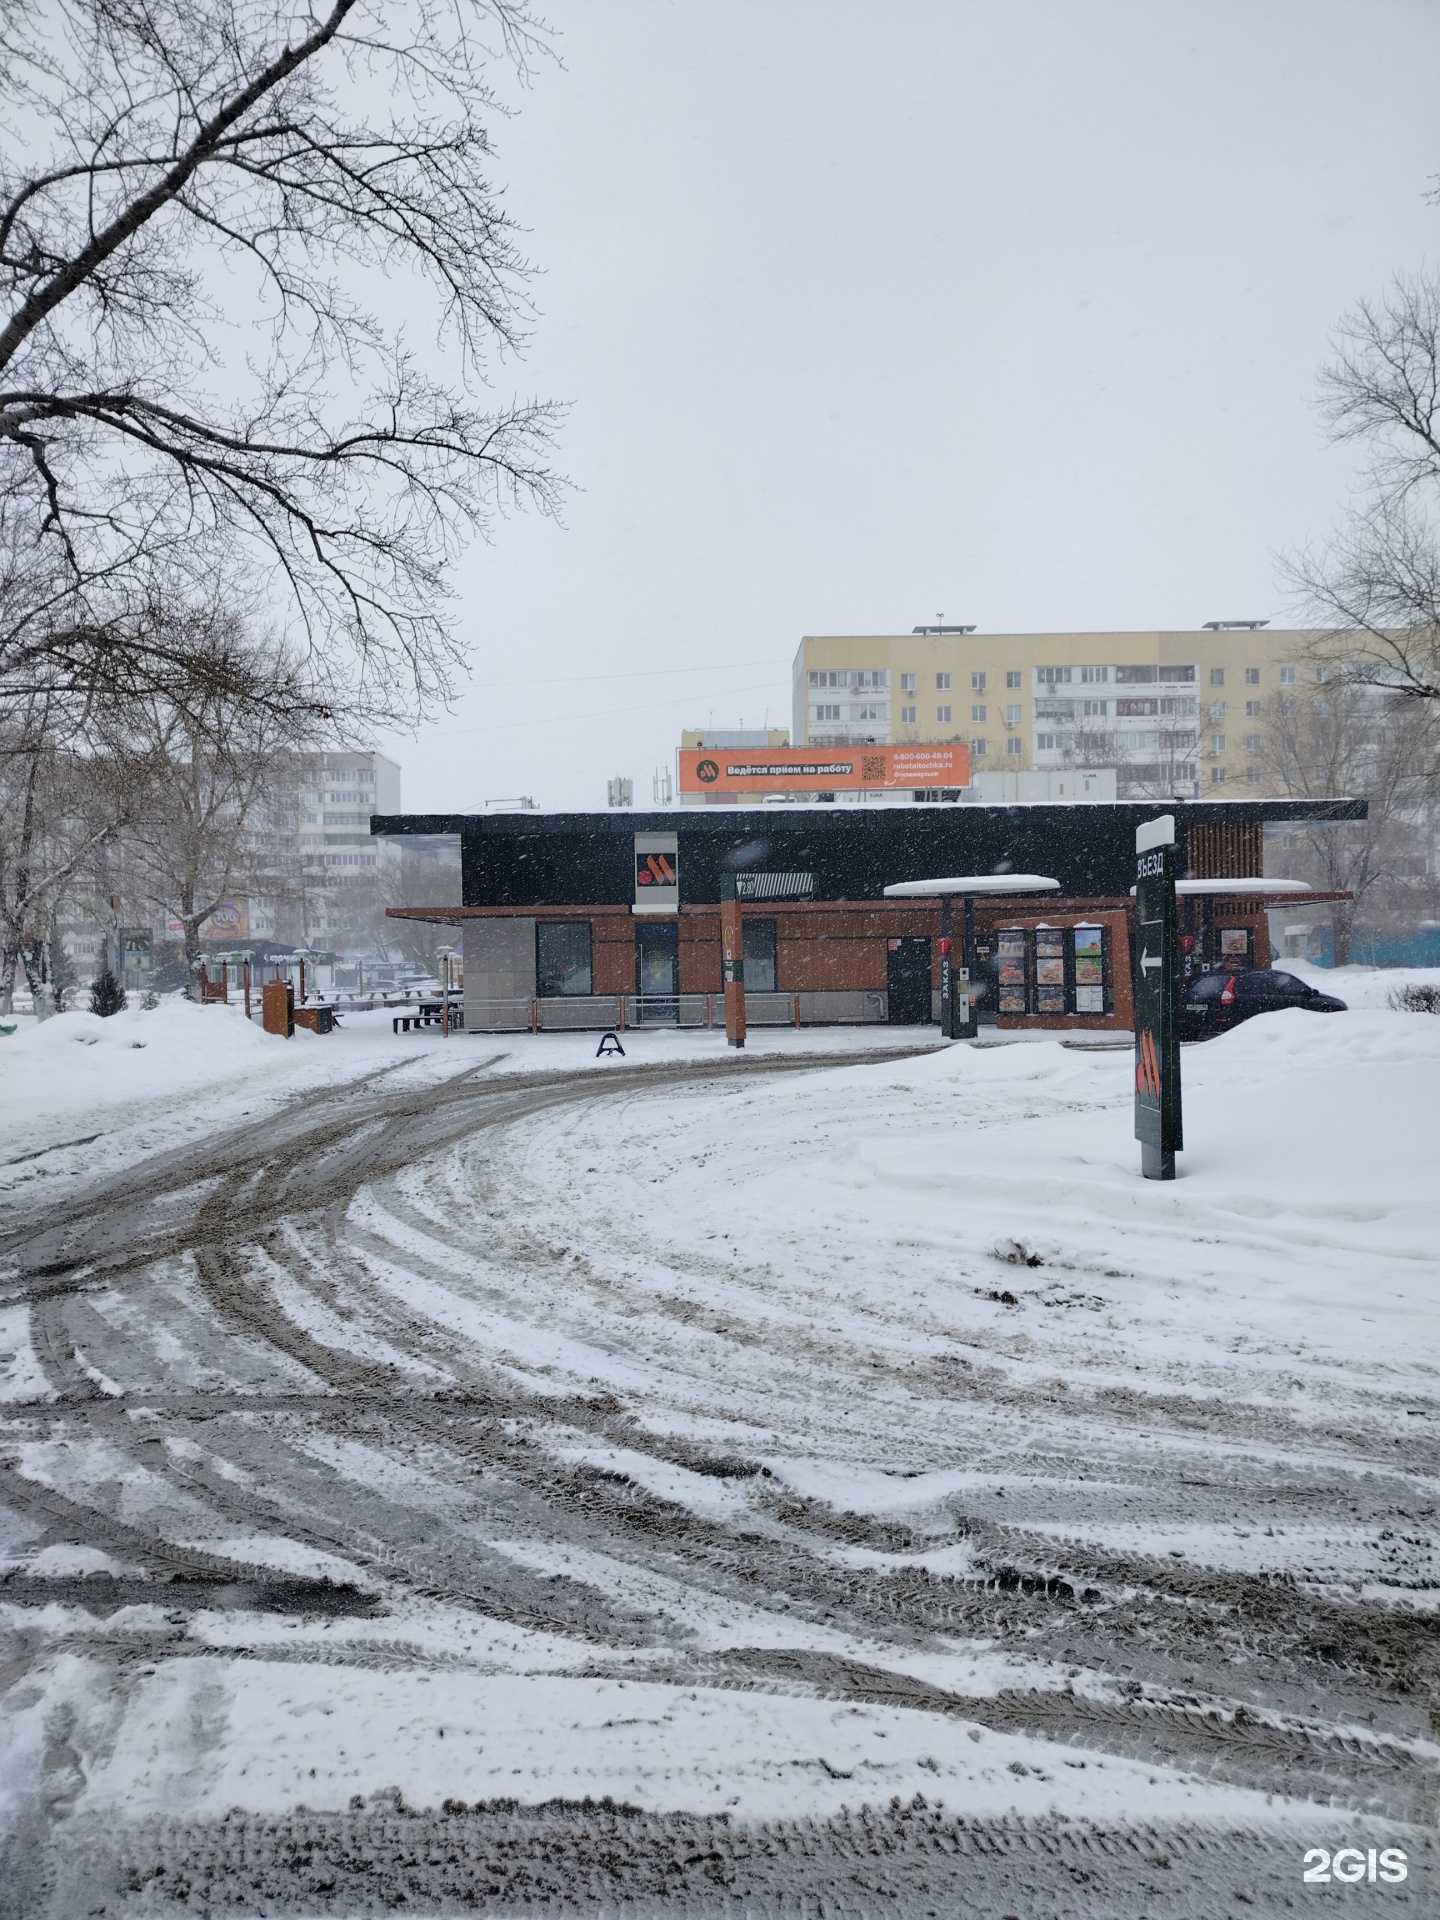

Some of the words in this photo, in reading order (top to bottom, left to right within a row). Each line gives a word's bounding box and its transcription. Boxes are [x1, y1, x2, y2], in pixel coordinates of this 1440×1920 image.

[803, 765, 815, 774] на
[817, 764, 852, 774] работу
[1137, 852, 1164, 878] ВЪЕЗД
